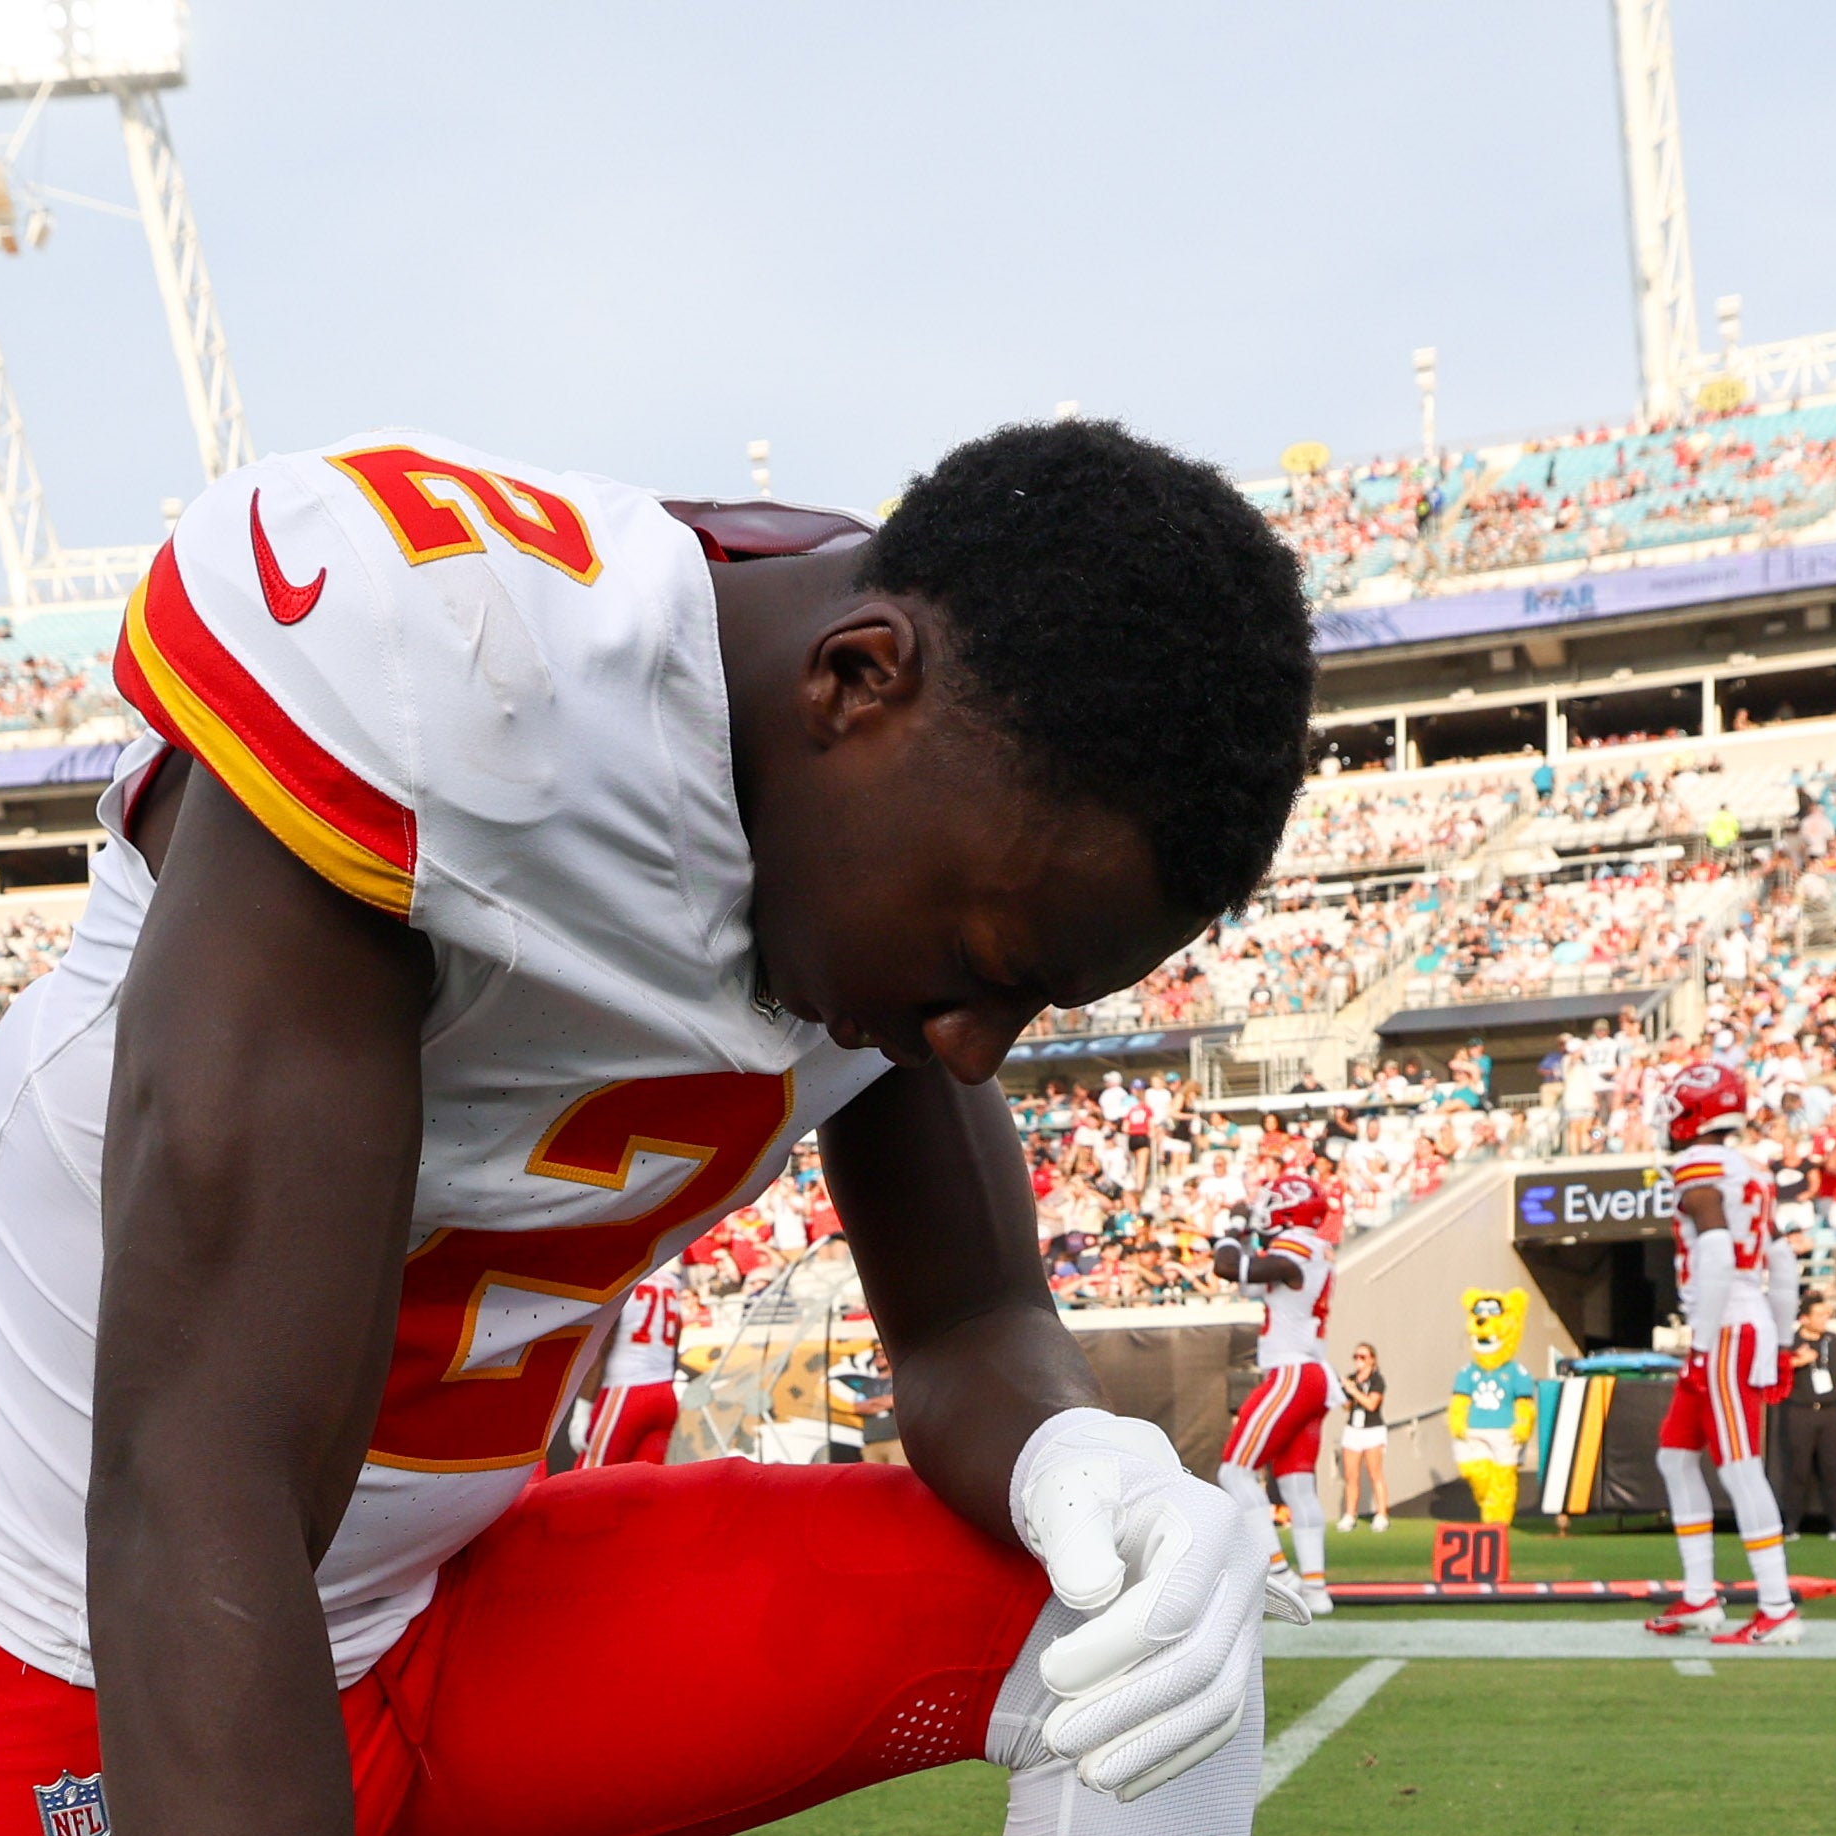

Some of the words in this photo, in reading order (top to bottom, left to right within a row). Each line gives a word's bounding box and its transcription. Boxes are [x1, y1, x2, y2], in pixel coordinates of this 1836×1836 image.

[1564, 1178, 1676, 1223] EverB
[629, 1284, 680, 1346] 76
[1442, 1529, 1501, 1581] 20
